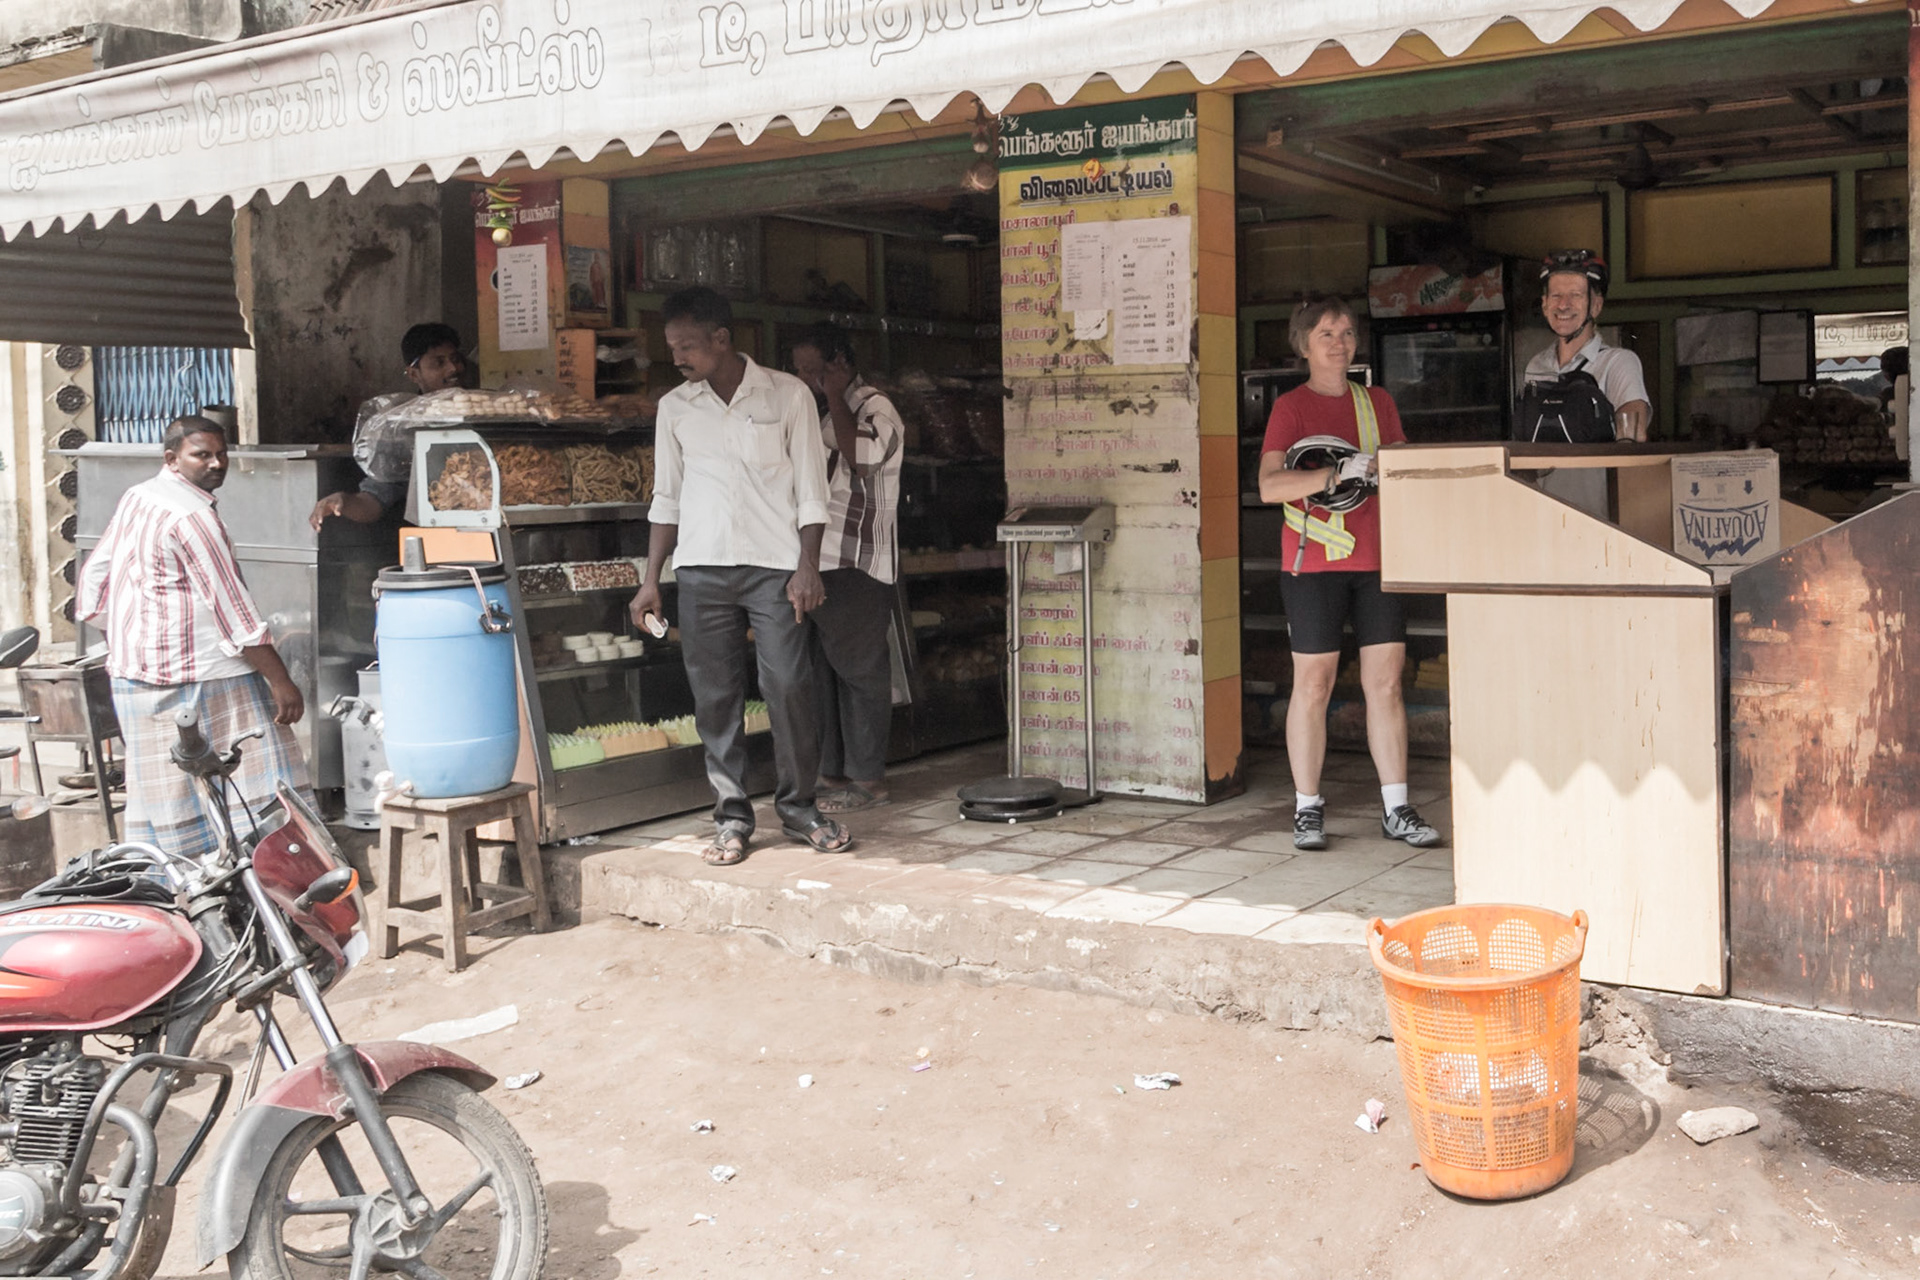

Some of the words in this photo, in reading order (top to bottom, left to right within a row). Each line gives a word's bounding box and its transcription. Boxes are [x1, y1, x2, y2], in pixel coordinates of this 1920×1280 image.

[193, 51, 347, 149] பேக்கரி
[1679, 503, 1769, 544] AQUAFINA
[1063, 690, 1080, 702] 65
[7, 911, 141, 931] PLATINA
